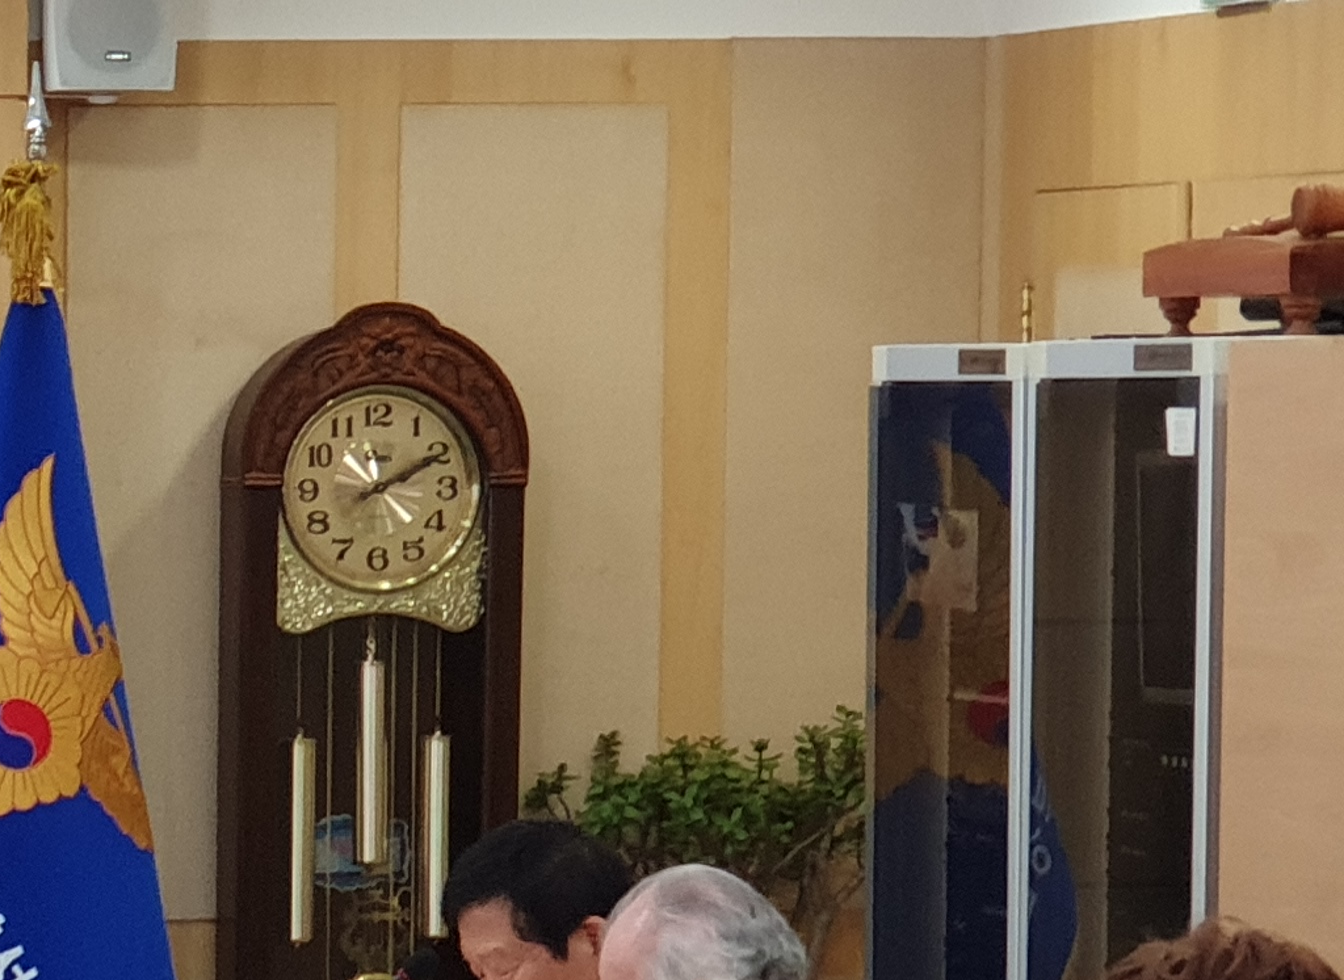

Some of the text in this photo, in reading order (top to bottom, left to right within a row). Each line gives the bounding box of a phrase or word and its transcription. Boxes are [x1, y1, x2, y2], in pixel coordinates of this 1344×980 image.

[331, 415, 354, 438] 11
[364, 403, 393, 428] 12
[411, 414, 421, 437] 1
[308, 443, 333, 468] 10
[427, 441, 451, 465] 2
[297, 478, 319, 503] 9
[436, 475, 458, 501] 3
[307, 510, 330, 535] 8
[423, 509, 447, 532] 4
[331, 537, 354, 561] 7
[366, 546, 390, 571] 6
[402, 536, 425, 562] 5
